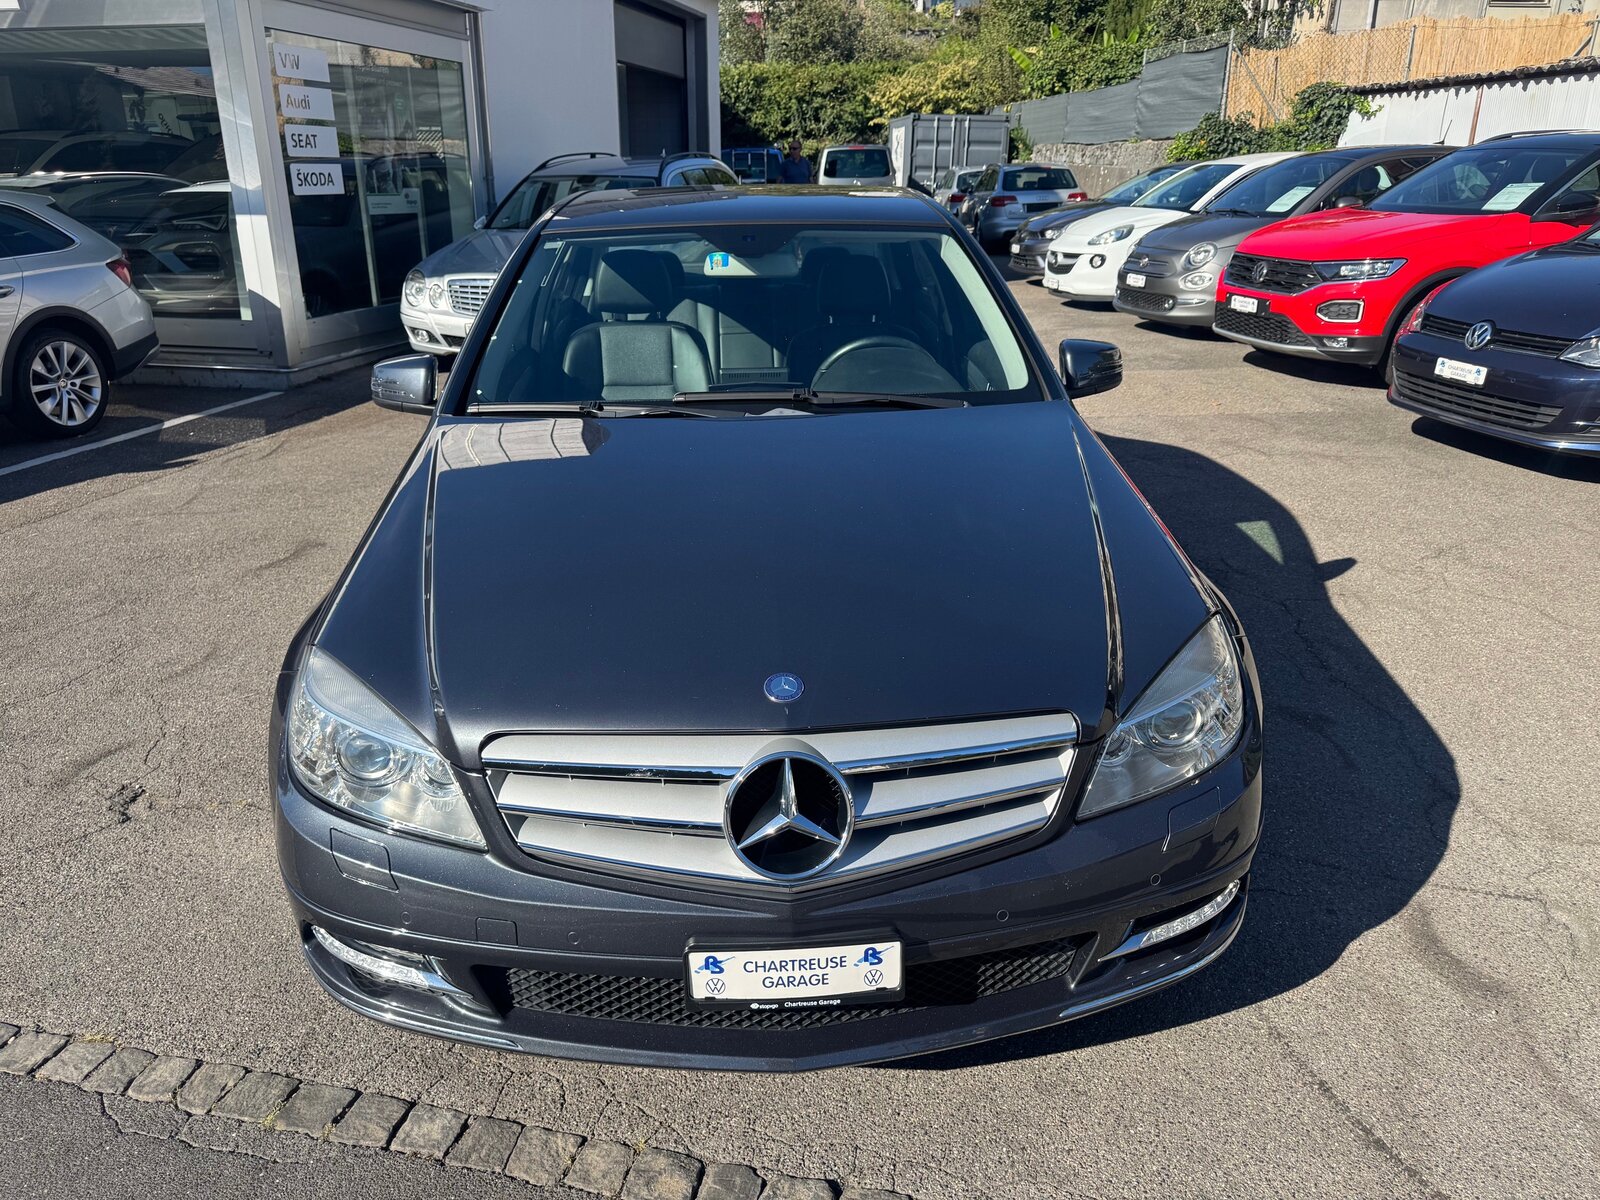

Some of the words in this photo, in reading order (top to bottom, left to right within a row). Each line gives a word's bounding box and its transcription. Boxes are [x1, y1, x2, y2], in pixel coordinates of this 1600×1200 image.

[278, 52, 300, 70] VW
[286, 94, 311, 110] Audi
[291, 133, 318, 149] SEAT
[296, 168, 335, 187] ŠKODA
[743, 955, 847, 973] CHARTREUSE
[762, 973, 829, 989] GARAGE
